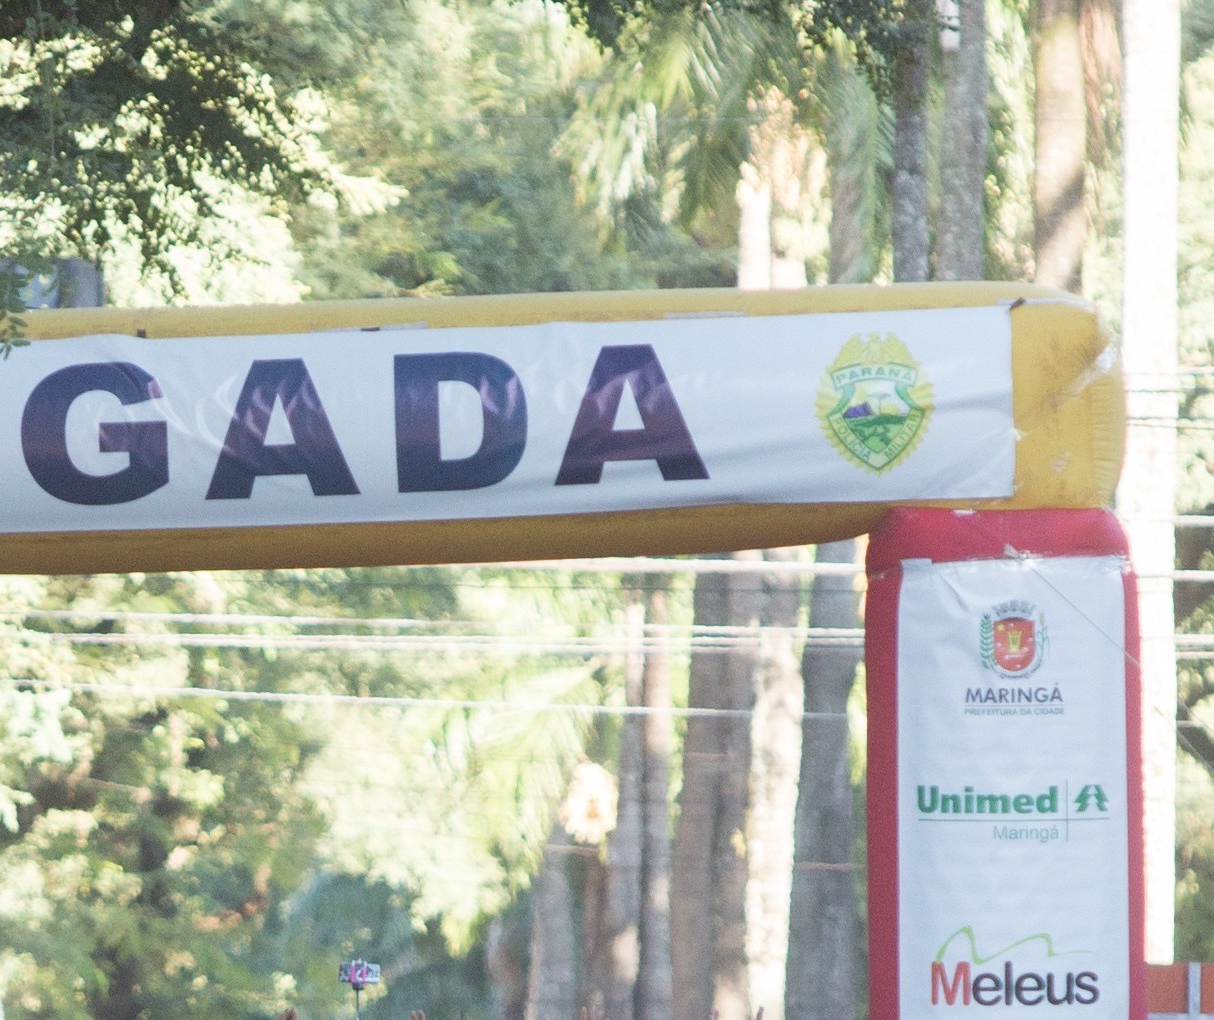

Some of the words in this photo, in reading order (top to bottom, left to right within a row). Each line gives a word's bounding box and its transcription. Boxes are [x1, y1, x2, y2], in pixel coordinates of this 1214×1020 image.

[964, 682, 1064, 703] MARINGÁ
[964, 707, 1018, 716] PREFEITURA
[1020, 707, 1032, 716] DA
[1034, 706, 1066, 716] CIDADE
[917, 784, 1059, 814] Unimed
[992, 825, 1060, 843] Maringá
[931, 960, 1100, 1006] Meleus
